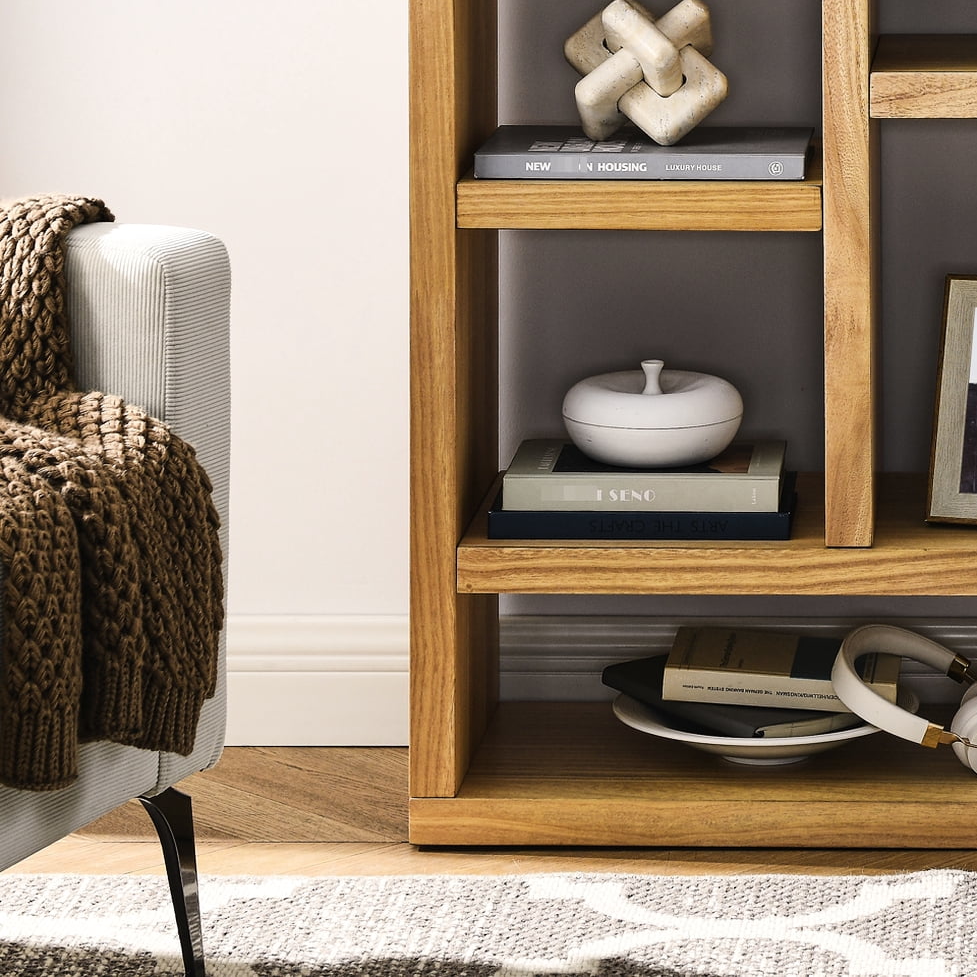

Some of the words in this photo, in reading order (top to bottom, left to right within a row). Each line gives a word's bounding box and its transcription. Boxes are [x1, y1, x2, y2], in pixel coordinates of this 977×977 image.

[525, 162, 551, 171] NEW
[597, 162, 647, 172] HOUSING
[665, 164, 695, 172] LUXURY
[696, 164, 722, 172] HOUSE
[588, 520, 646, 533] CRAFTS
[653, 520, 682, 533] THE
[690, 520, 729, 533] ARTS
